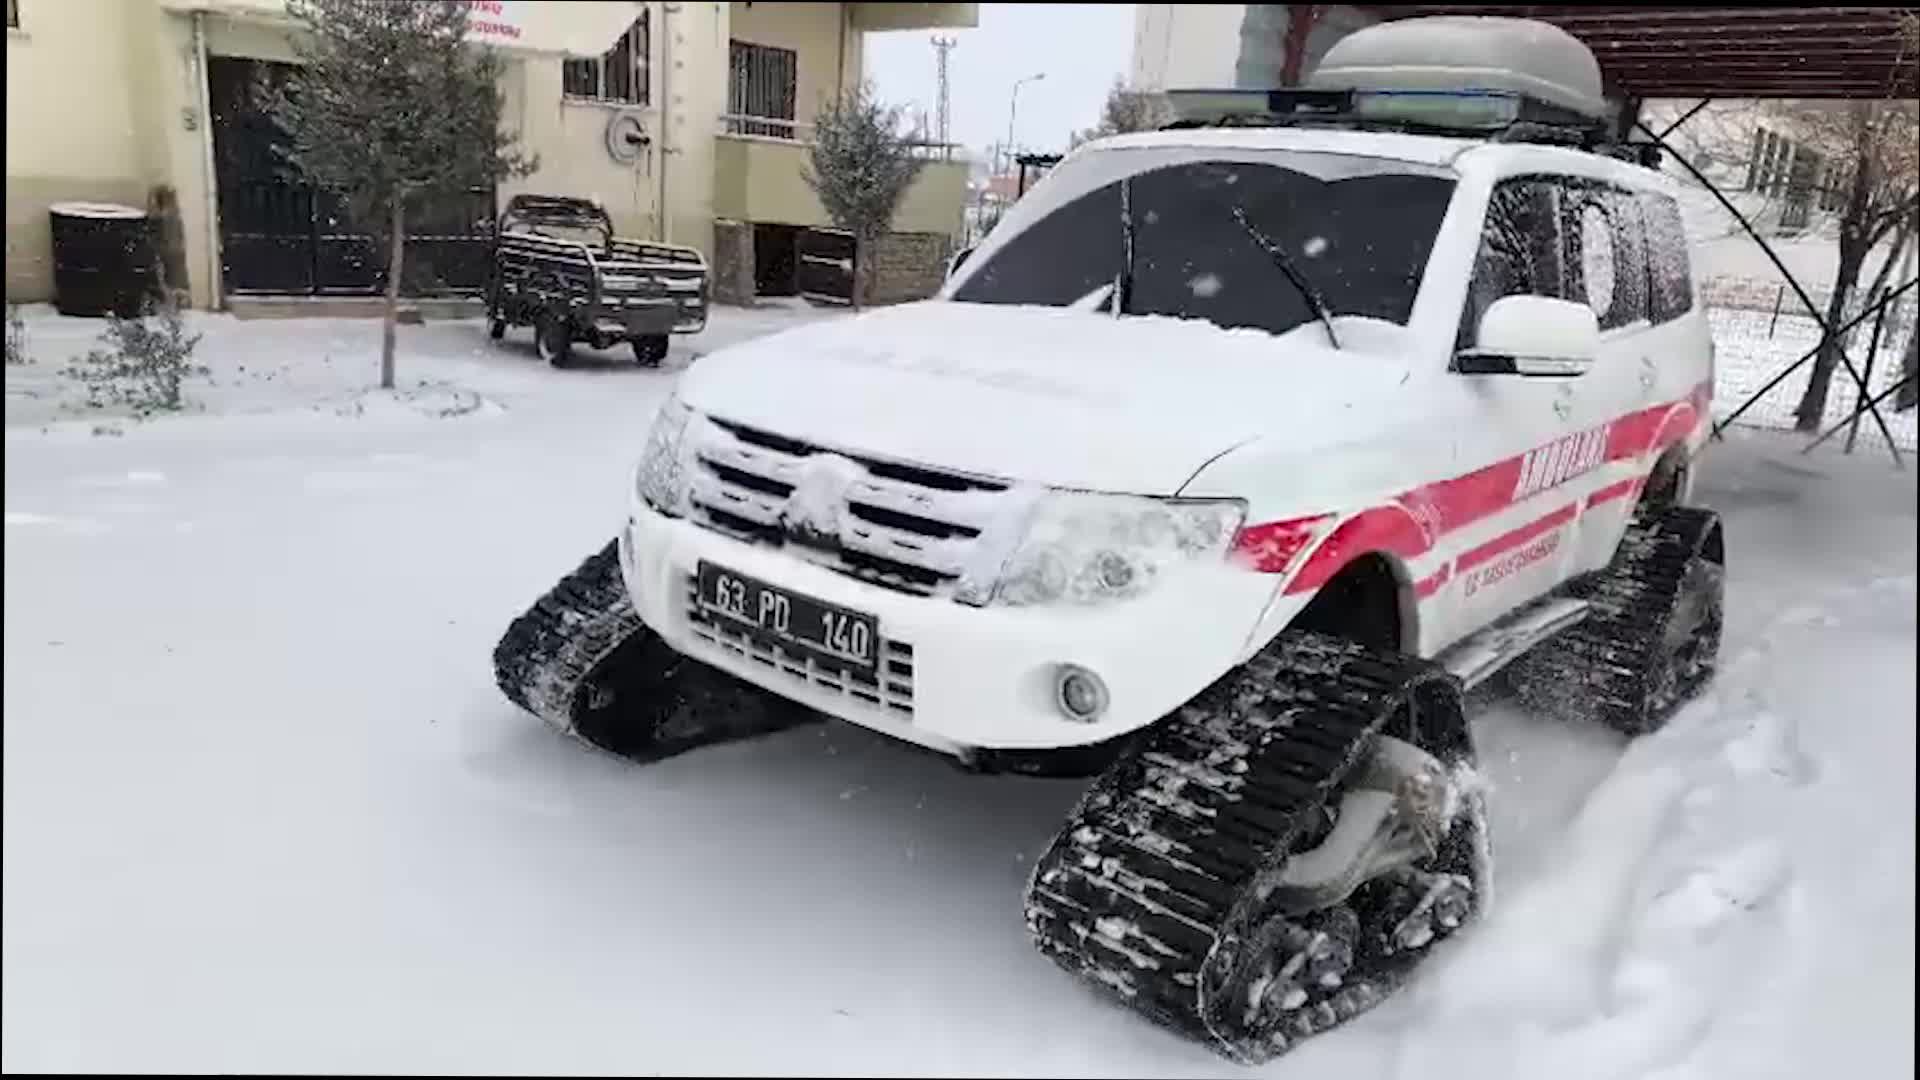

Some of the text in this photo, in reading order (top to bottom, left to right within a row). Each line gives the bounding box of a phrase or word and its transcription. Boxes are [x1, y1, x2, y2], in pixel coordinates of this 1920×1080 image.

[716, 574, 869, 658] 63 PD 140
